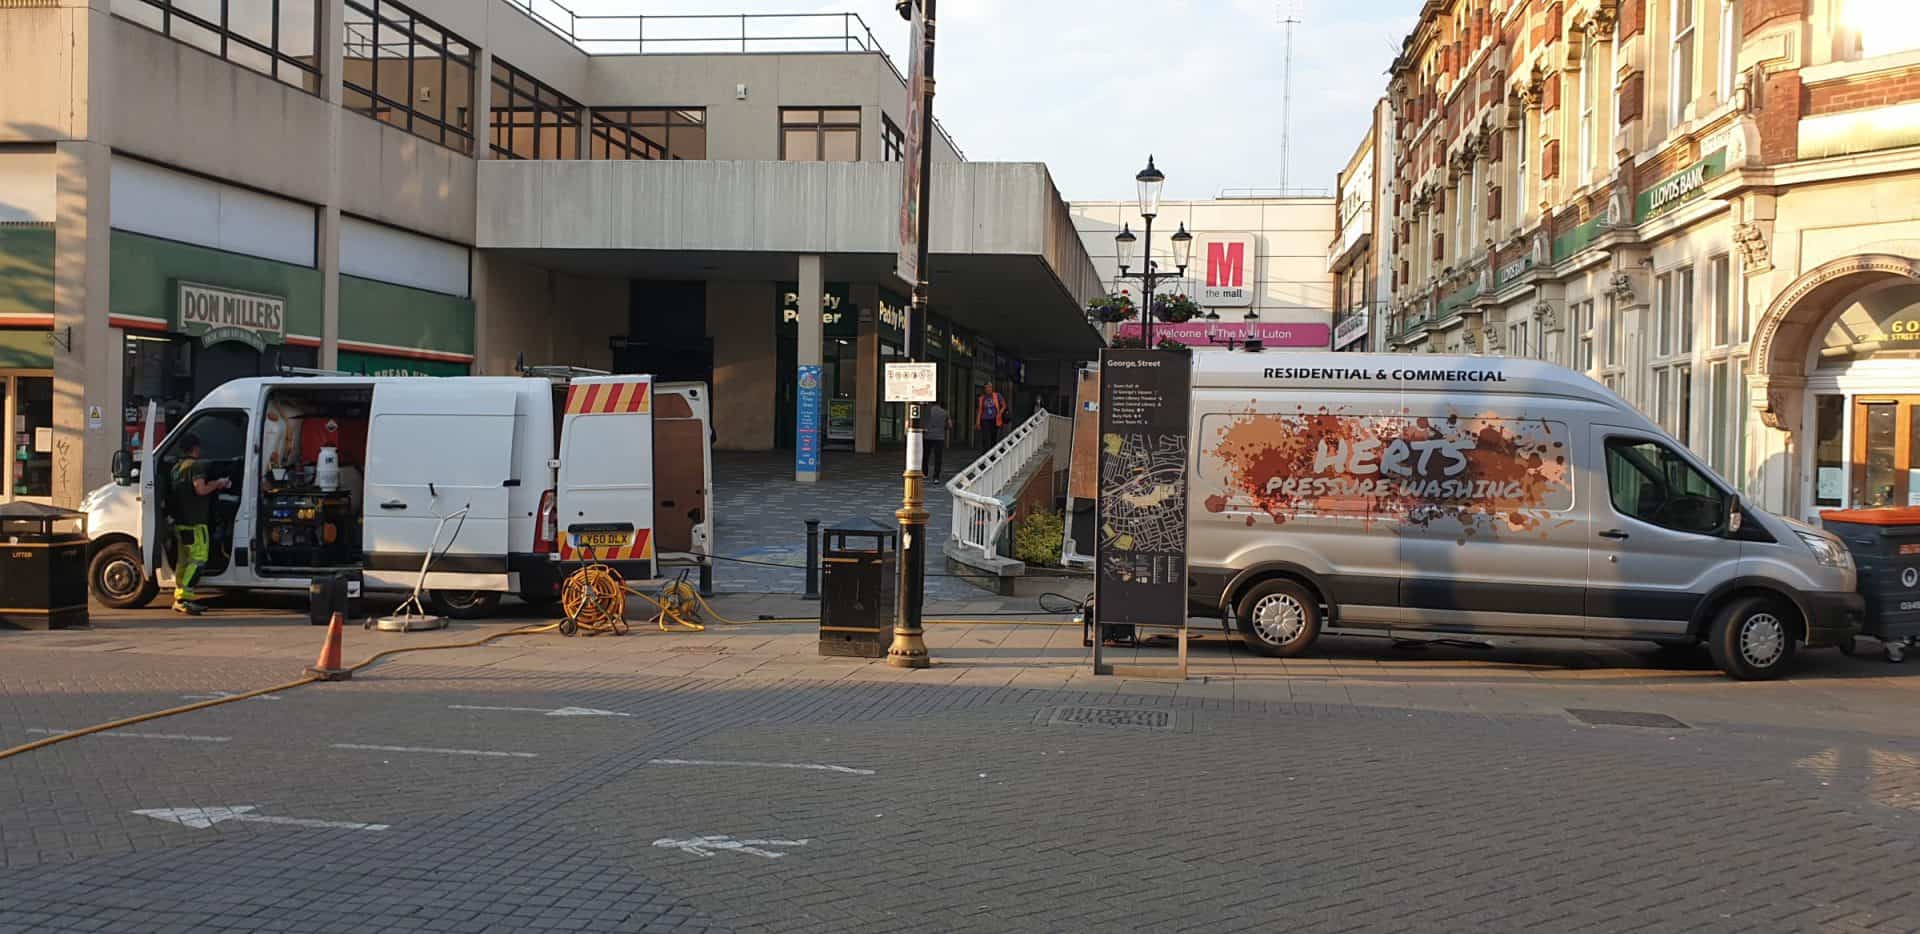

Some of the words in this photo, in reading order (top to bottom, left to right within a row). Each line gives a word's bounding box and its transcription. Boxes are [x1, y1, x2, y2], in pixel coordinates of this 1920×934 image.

[1650, 179, 1680, 209] LLOYDS
[1680, 164, 1704, 195] BANK
[1206, 242, 1244, 287] M
[1206, 289, 1220, 298] the
[1223, 289, 1242, 298] mall
[184, 290, 219, 323] DON
[223, 296, 281, 330] MILLERS
[879, 300, 898, 331] Paddy
[1156, 328, 1201, 339] Welcome
[1217, 328, 1236, 338] The
[1262, 328, 1292, 339] Luton
[1263, 367, 1371, 380] RESIDENTIAL
[1376, 369, 1387, 380] &
[1392, 369, 1507, 382] COMMERCIAL
[1313, 437, 1476, 476] HERTS
[1265, 476, 1391, 497] PRESSURE
[1399, 479, 1524, 499] WASHING
